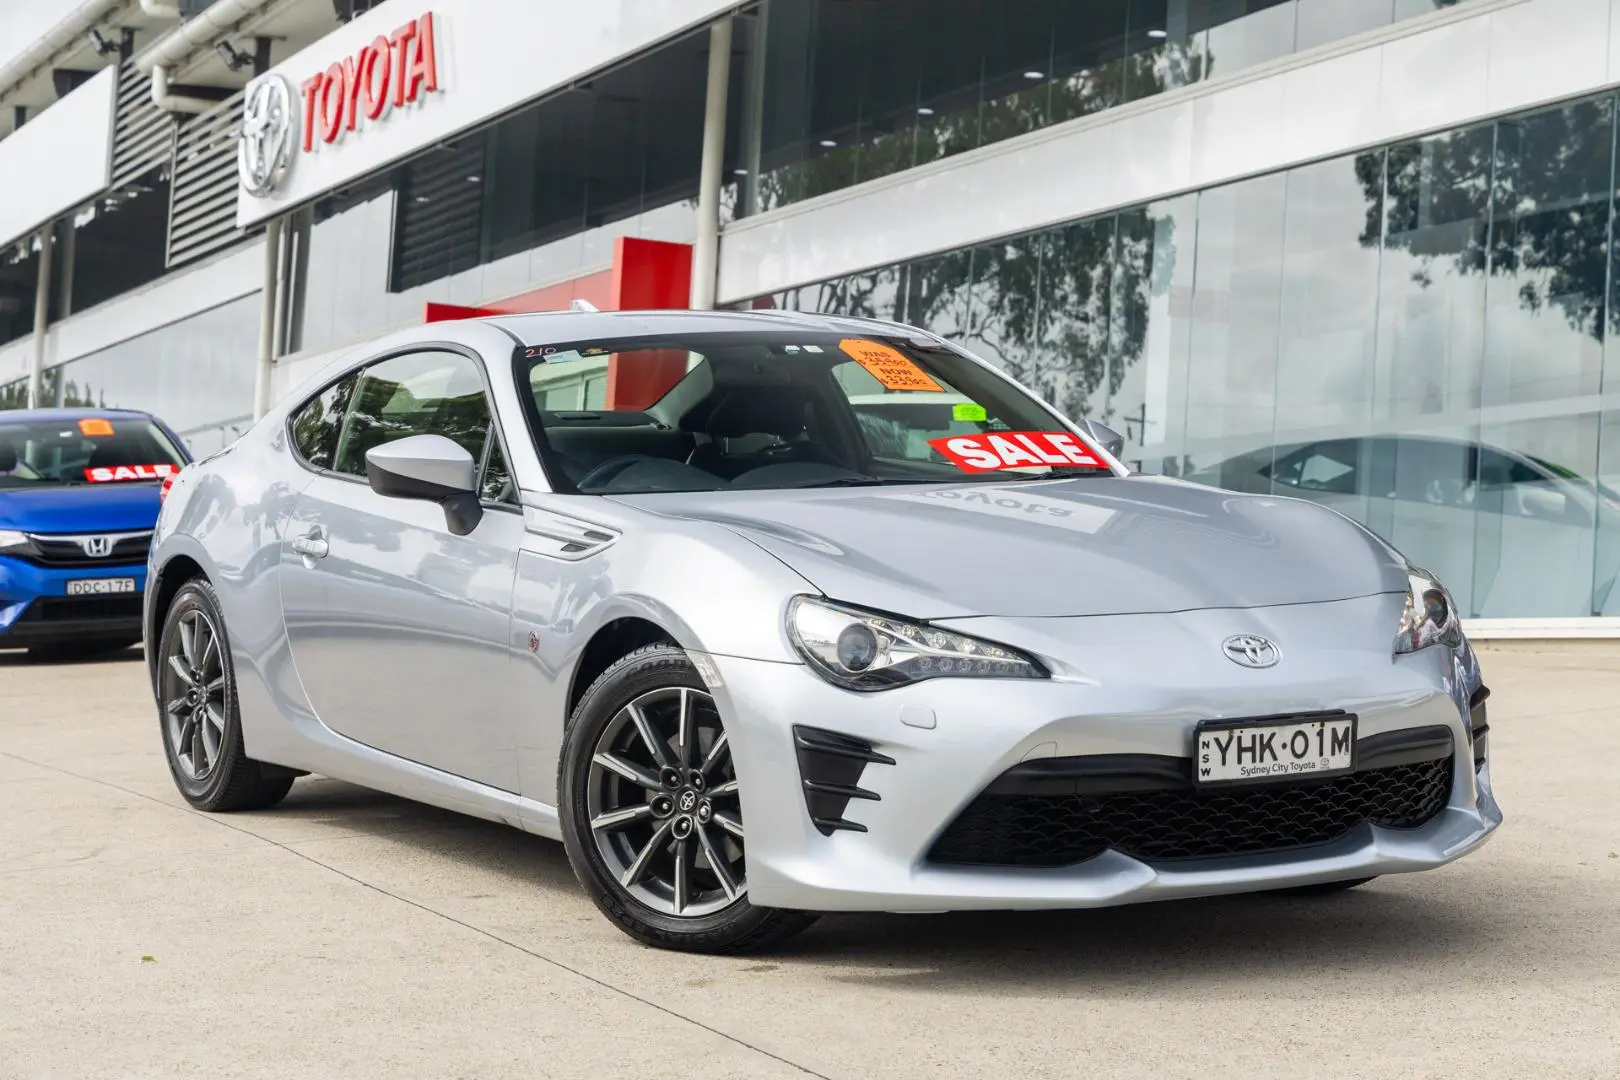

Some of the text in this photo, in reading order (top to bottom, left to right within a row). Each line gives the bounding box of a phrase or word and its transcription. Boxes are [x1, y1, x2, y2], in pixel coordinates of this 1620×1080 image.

[301, 11, 437, 153] TOYOTA
[879, 368, 913, 376] NOW
[946, 433, 1099, 469] SALE
[91, 464, 172, 482] SALE
[1240, 761, 1316, 776] Sydney City Toyota
